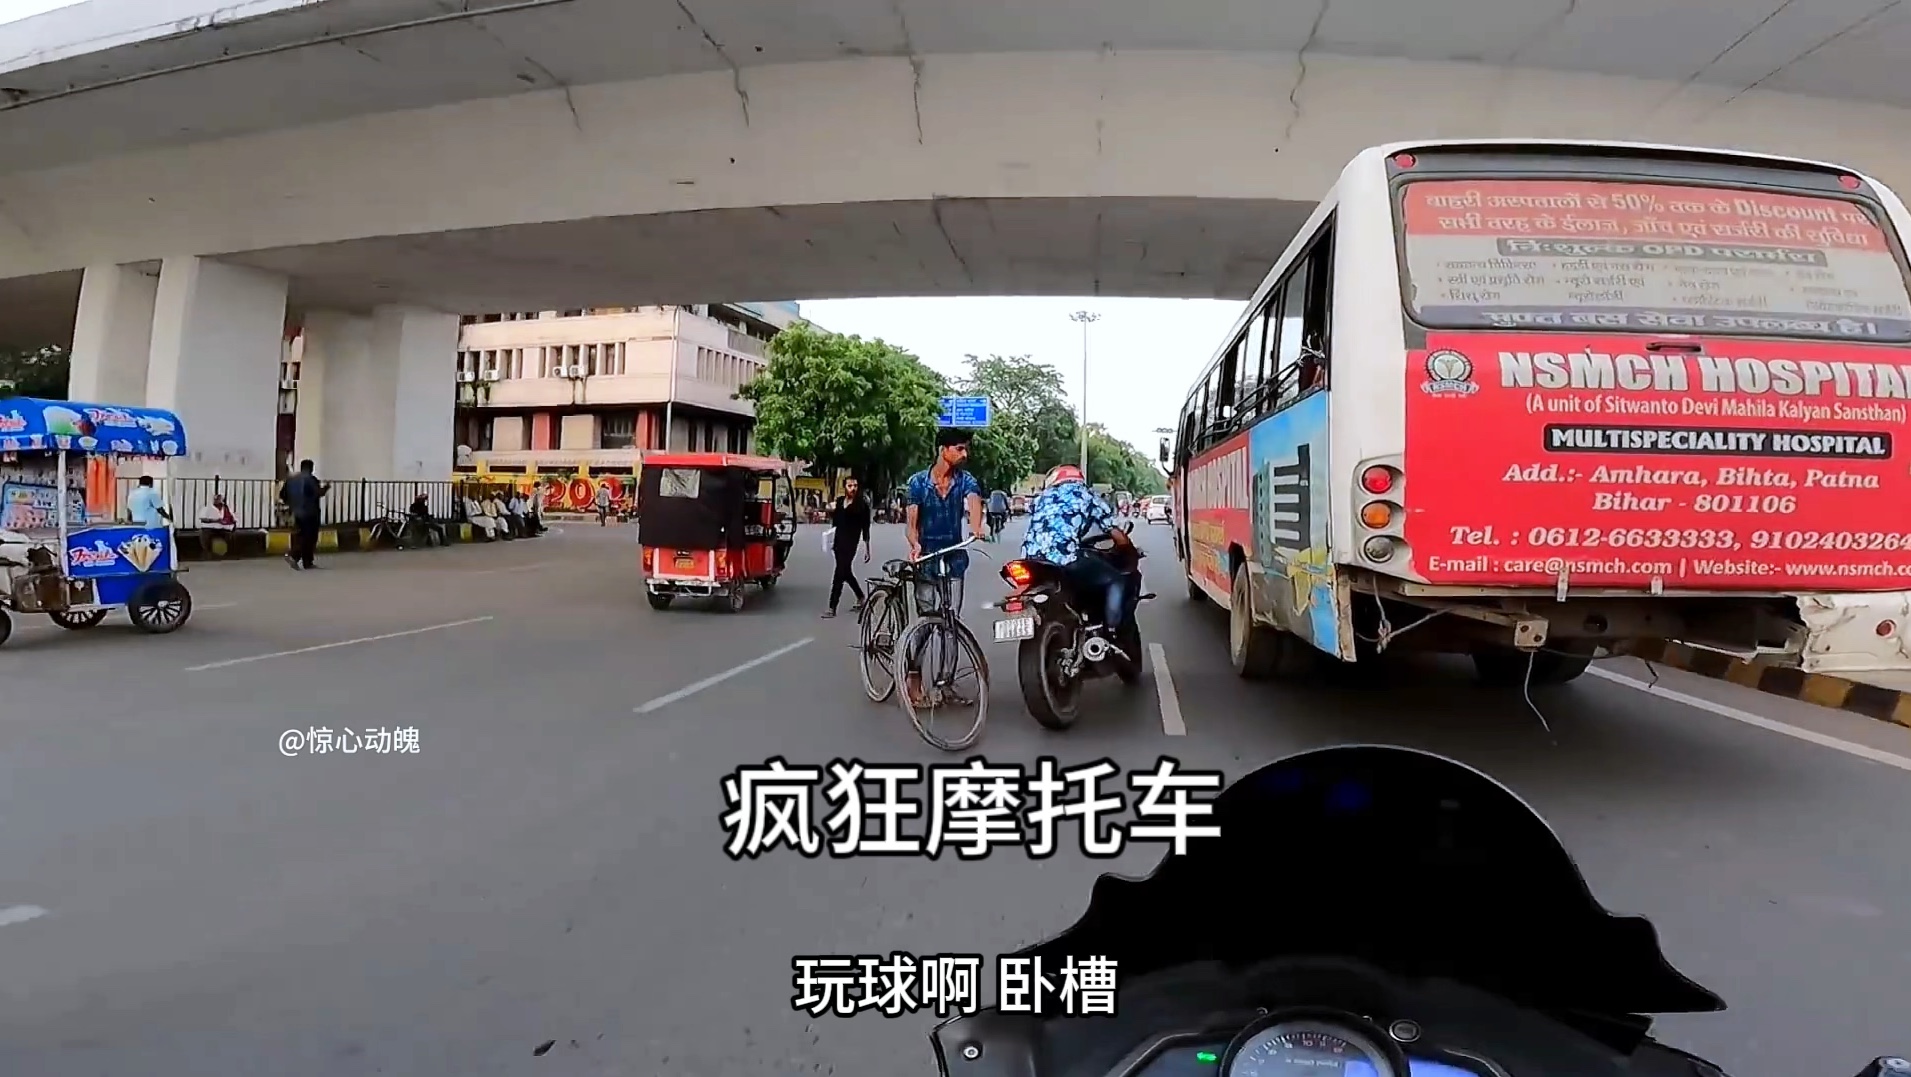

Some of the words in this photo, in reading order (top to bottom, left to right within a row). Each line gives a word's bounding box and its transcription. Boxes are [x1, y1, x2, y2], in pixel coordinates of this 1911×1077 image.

[1611, 194, 1662, 214] 50%
[1735, 198, 1838, 223] Discount
[1642, 243, 1704, 257] OPD
[1499, 351, 1689, 391] NSMCH
[1526, 393, 1544, 413] (A
[1548, 395, 1581, 413] unit
[1585, 395, 1602, 413] of
[1605, 395, 1678, 416] Sitwanto
[1682, 397, 1718, 416] Devi
[1722, 398, 1776, 419] Mahila
[1779, 400, 1831, 423] Kalyan
[1834, 402, 1906, 424] Sansthan)
[1551, 428, 1768, 451] MULTISPECIALITY
[1772, 434, 1886, 455] HOSPITAL
[1502, 463, 1583, 482] Add.:-
[1589, 465, 1708, 487] Amhara,
[1716, 466, 1797, 488] Bihta,
[1804, 469, 1880, 489] Patna
[1592, 490, 1672, 511] Bihar
[1693, 494, 1797, 514] 801106
[1450, 525, 1500, 546] Tel.
[1528, 526, 1742, 551] 0612-6633333,
[1428, 555, 1489, 572] E-mail
[1503, 556, 1673, 575] care@nsmch.com
[1693, 558, 1782, 576] Website:-
